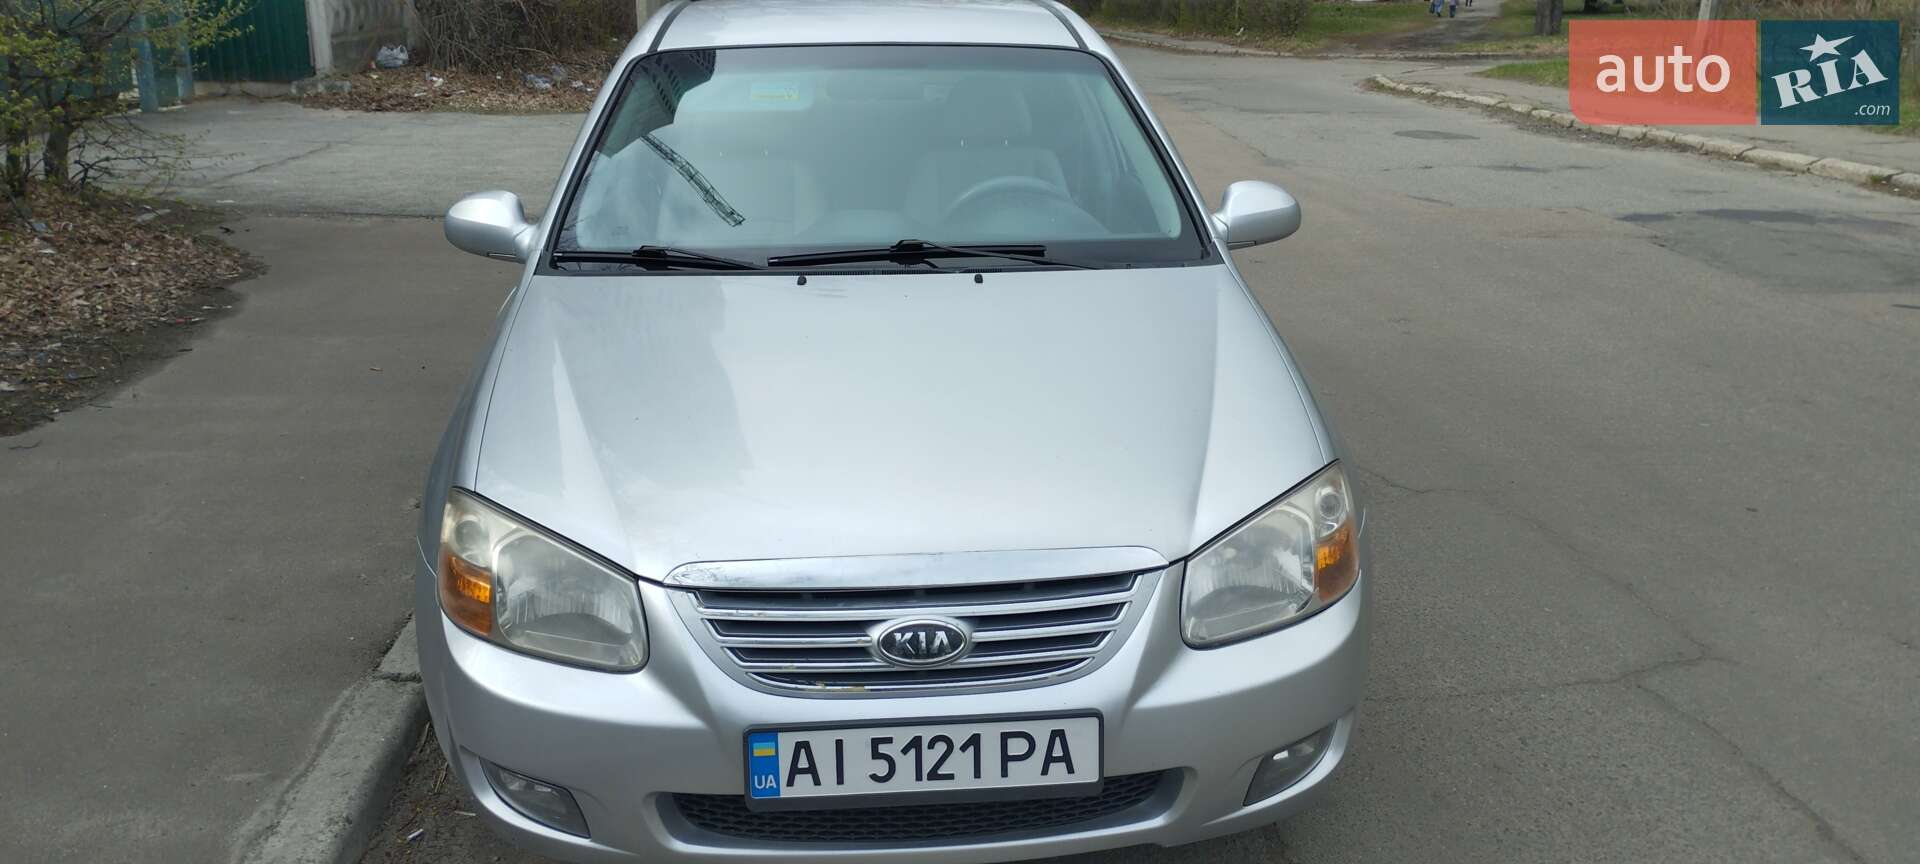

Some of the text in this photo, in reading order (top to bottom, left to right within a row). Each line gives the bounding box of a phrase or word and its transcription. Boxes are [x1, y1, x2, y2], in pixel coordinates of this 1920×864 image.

[893, 630, 953, 655] KIA
[786, 729, 1075, 787] AI 5121 PA
[754, 775, 777, 789] UA
